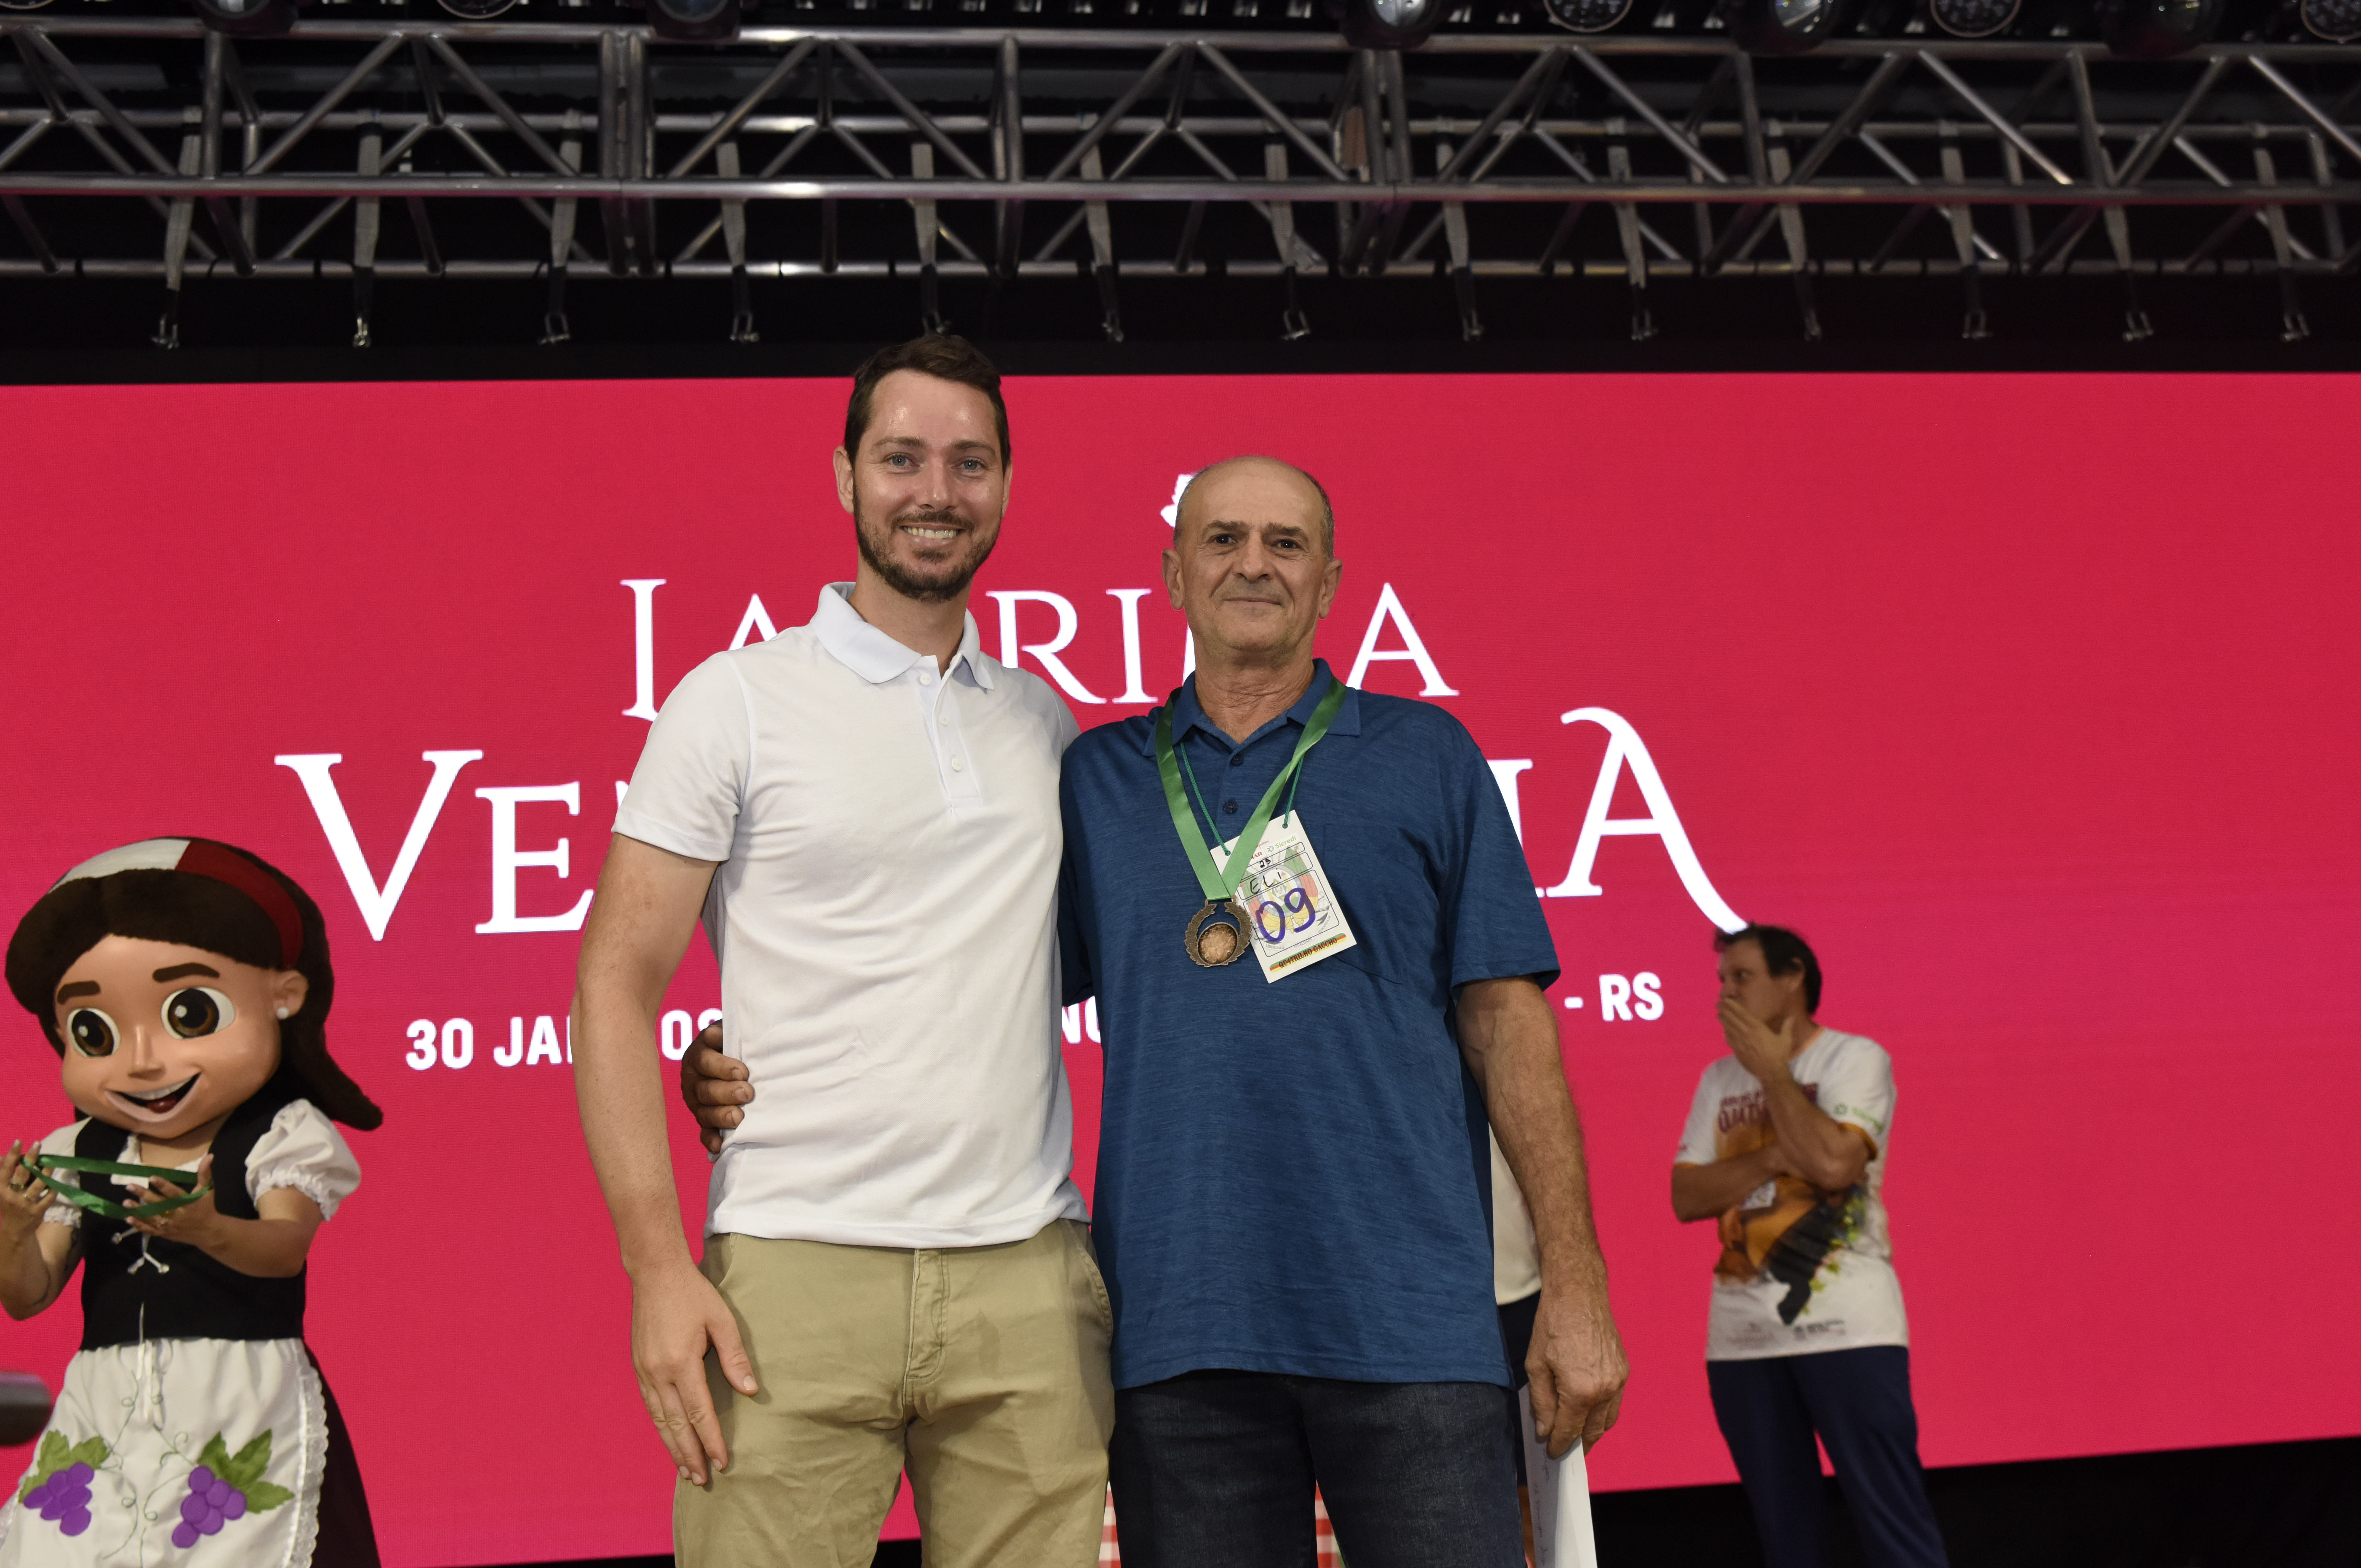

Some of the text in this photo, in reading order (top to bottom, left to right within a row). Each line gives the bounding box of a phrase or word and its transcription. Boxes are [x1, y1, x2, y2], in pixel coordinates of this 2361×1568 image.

[1275, 835, 1296, 849] Sicredi
[1255, 887, 1316, 942] 09
[405, 1018, 473, 1070] 30
[493, 1015, 573, 1067] JA
[1599, 972, 1664, 1022] RS
